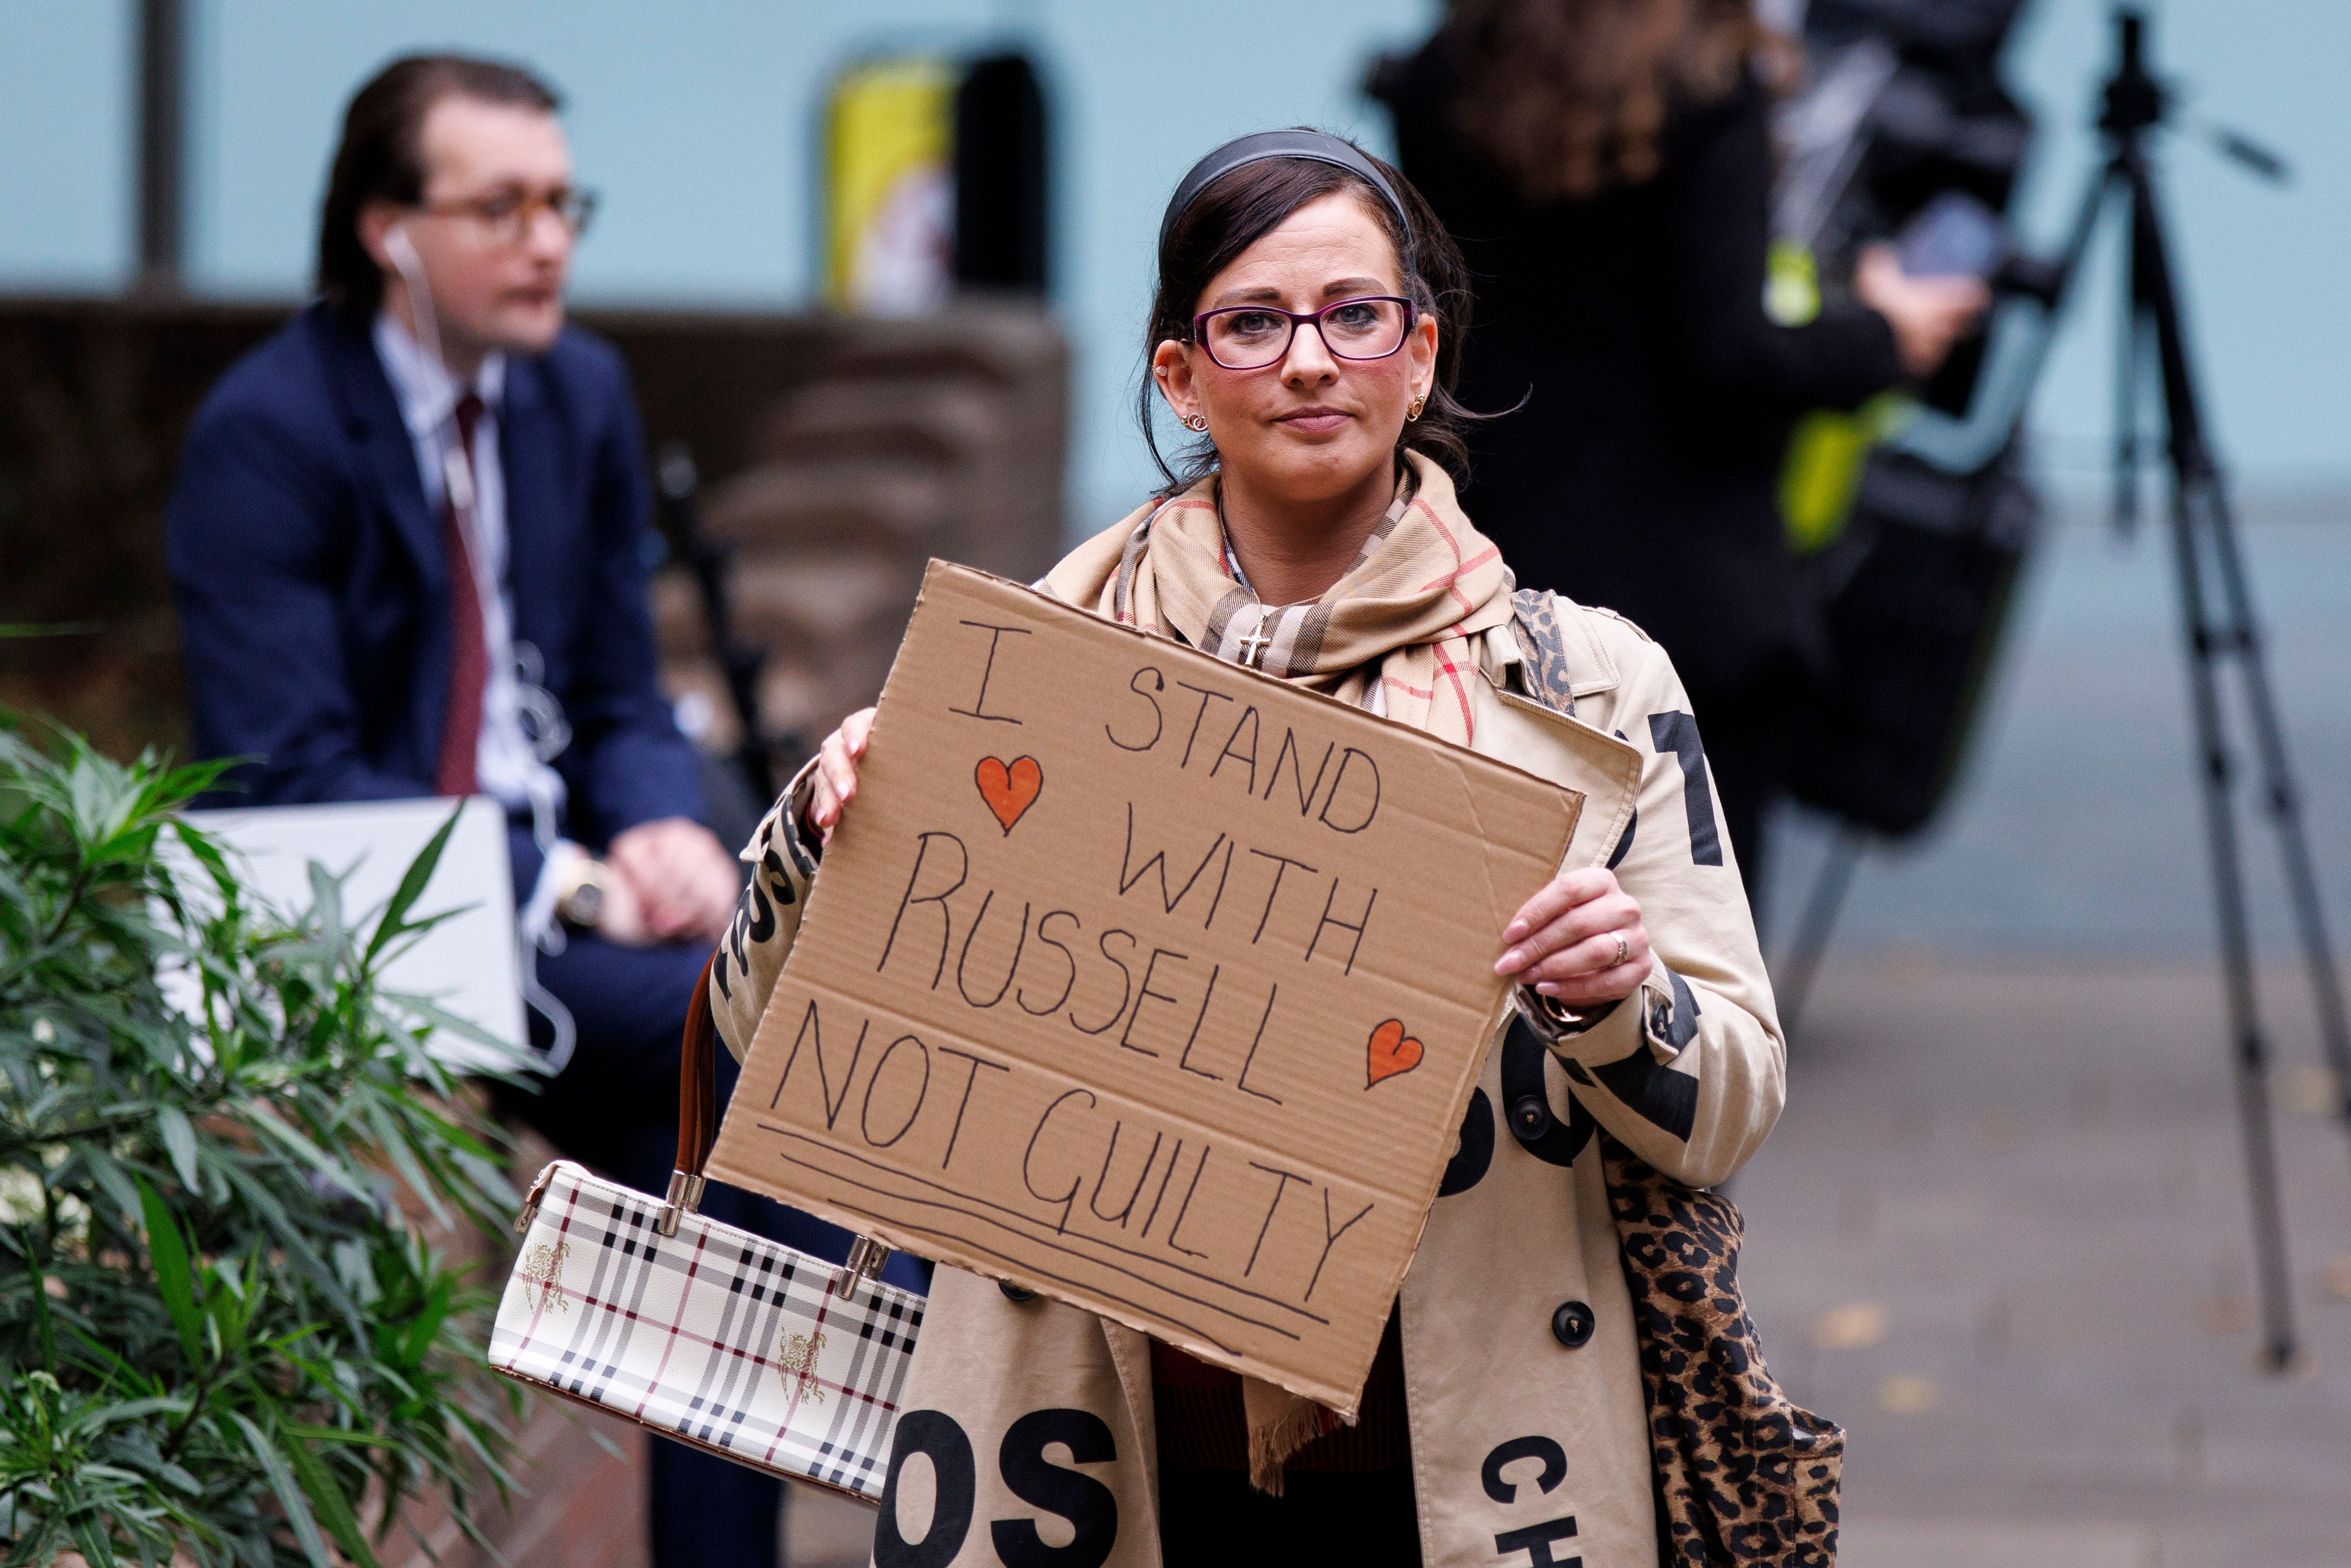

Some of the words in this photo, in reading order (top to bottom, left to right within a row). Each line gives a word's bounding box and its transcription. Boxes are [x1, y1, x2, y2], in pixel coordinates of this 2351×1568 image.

[949, 619, 1032, 724] I
[1105, 667, 1380, 832] STAND
[877, 832, 1282, 1104] RUSSELL
[1119, 803, 1378, 975] WITH
[770, 1000, 1009, 1168] NOT
[1023, 1089, 1375, 1301] GUILTY
